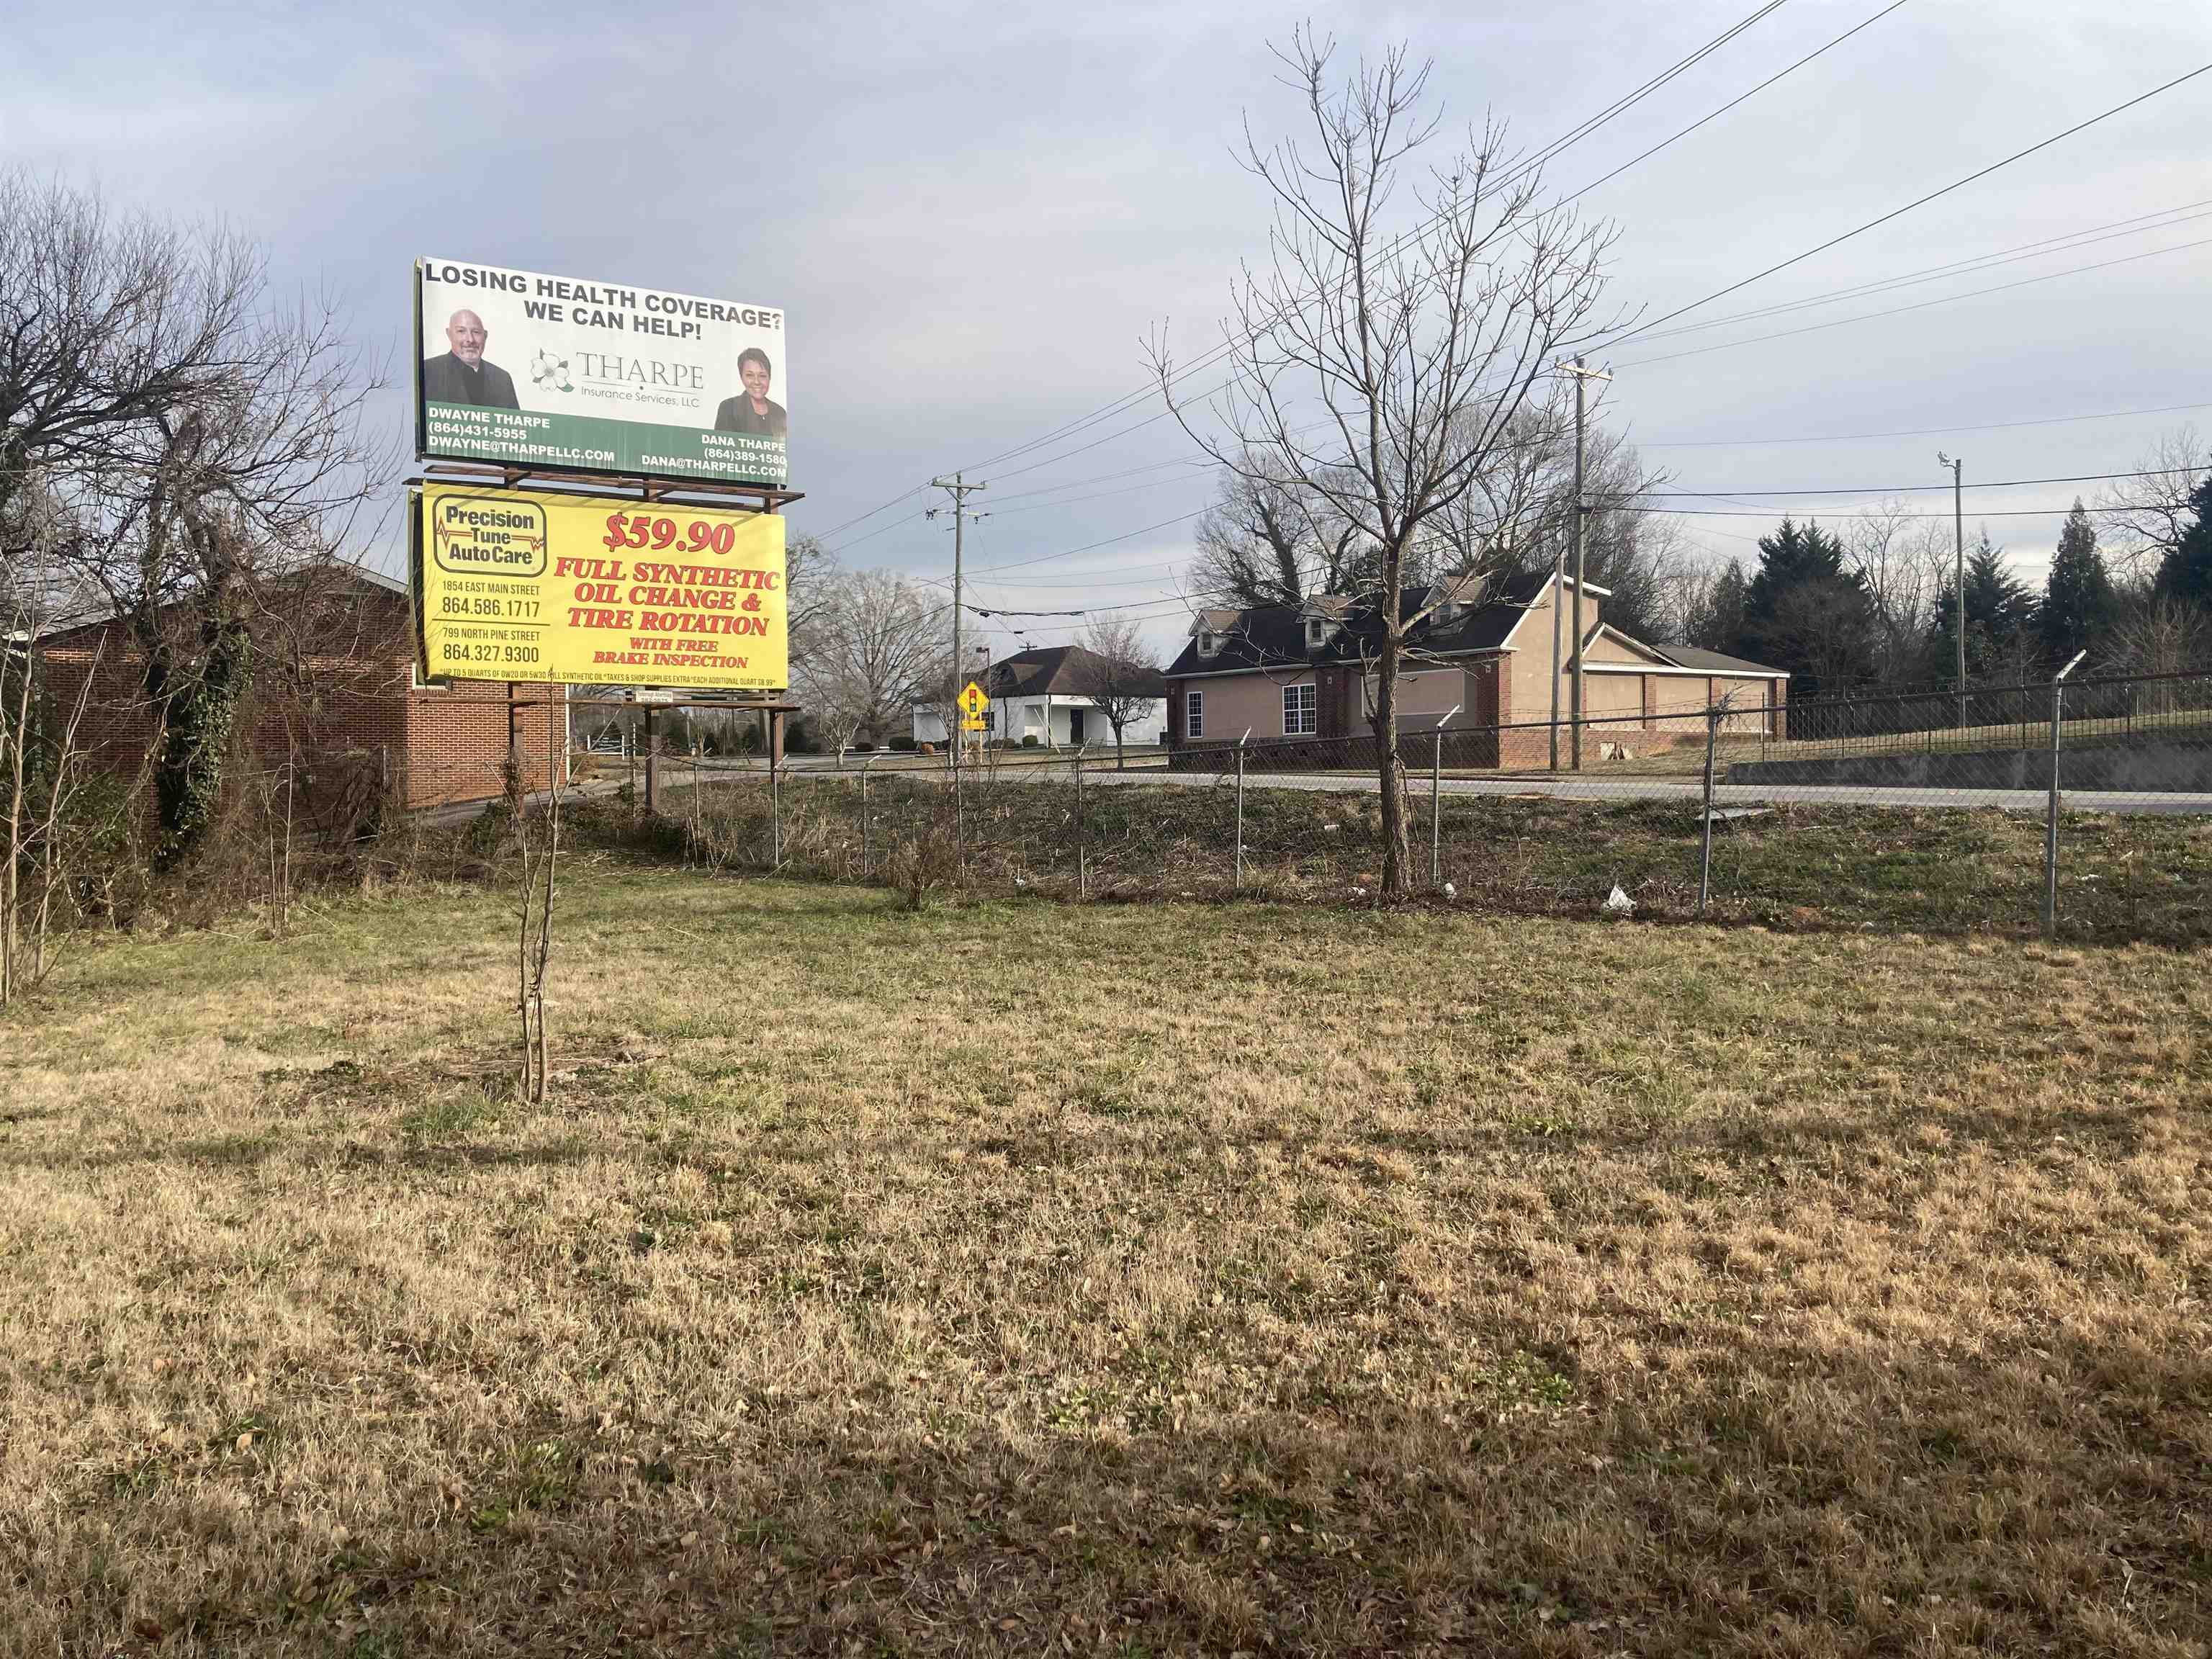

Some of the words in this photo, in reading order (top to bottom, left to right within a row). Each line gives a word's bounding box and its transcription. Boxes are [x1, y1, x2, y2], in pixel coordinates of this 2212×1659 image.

[426, 264, 527, 293] LOSING
[536, 279, 636, 309] HEALTH
[645, 295, 783, 330] COVERAGE?
[524, 300, 563, 322] WE
[572, 307, 624, 330] CAN
[634, 315, 701, 340] HELP!
[576, 352, 703, 389] THARPE
[581, 386, 633, 400] Insurance
[681, 397, 700, 408] LLC
[428, 408, 490, 423] DWAYNE
[494, 413, 550, 428] THARPE
[428, 421, 527, 440] (864)431-5955
[428, 436, 615, 462] DWAYNE@THARPELLC.COM
[701, 434, 735, 447] DANA
[738, 439, 786, 452] THARPE
[642, 455, 787, 477] DANA@THARPELLC.COM
[704, 448, 787, 465] (864)389-1580
[446, 505, 534, 529] Precision
[470, 528, 511, 544] Tune
[603, 512, 735, 554] $59.90
[554, 557, 626, 581] FULL
[632, 562, 781, 590] SYNTHETIC
[442, 580, 463, 592] 1854
[465, 582, 485, 593] EAST
[487, 583, 508, 594] MAIN
[511, 584, 541, 596] STREET
[575, 583, 622, 604] OIL
[629, 585, 737, 611] CHANGE
[741, 593, 762, 612] &
[442, 596, 540, 618] 864.586.1717
[567, 608, 634, 629] TIRE
[639, 611, 770, 637] ROTATION
[443, 627, 459, 638] 799
[461, 628, 488, 639] NORTH
[490, 629, 509, 640] PINE
[511, 630, 541, 642] STREET
[629, 637, 674, 652] WITH
[675, 639, 719, 653] FREE
[443, 644, 539, 662] 864.327.9300
[593, 651, 649, 665] BRAKE
[652, 653, 749, 669] INSPECTION
[462, 668, 467, 677] 5
[562, 673, 593, 681] SYNTHETIC
[631, 674, 646, 683] SHOP
[646, 675, 672, 683] SUPPLIES
[708, 676, 739, 685] ADDITIONAL
